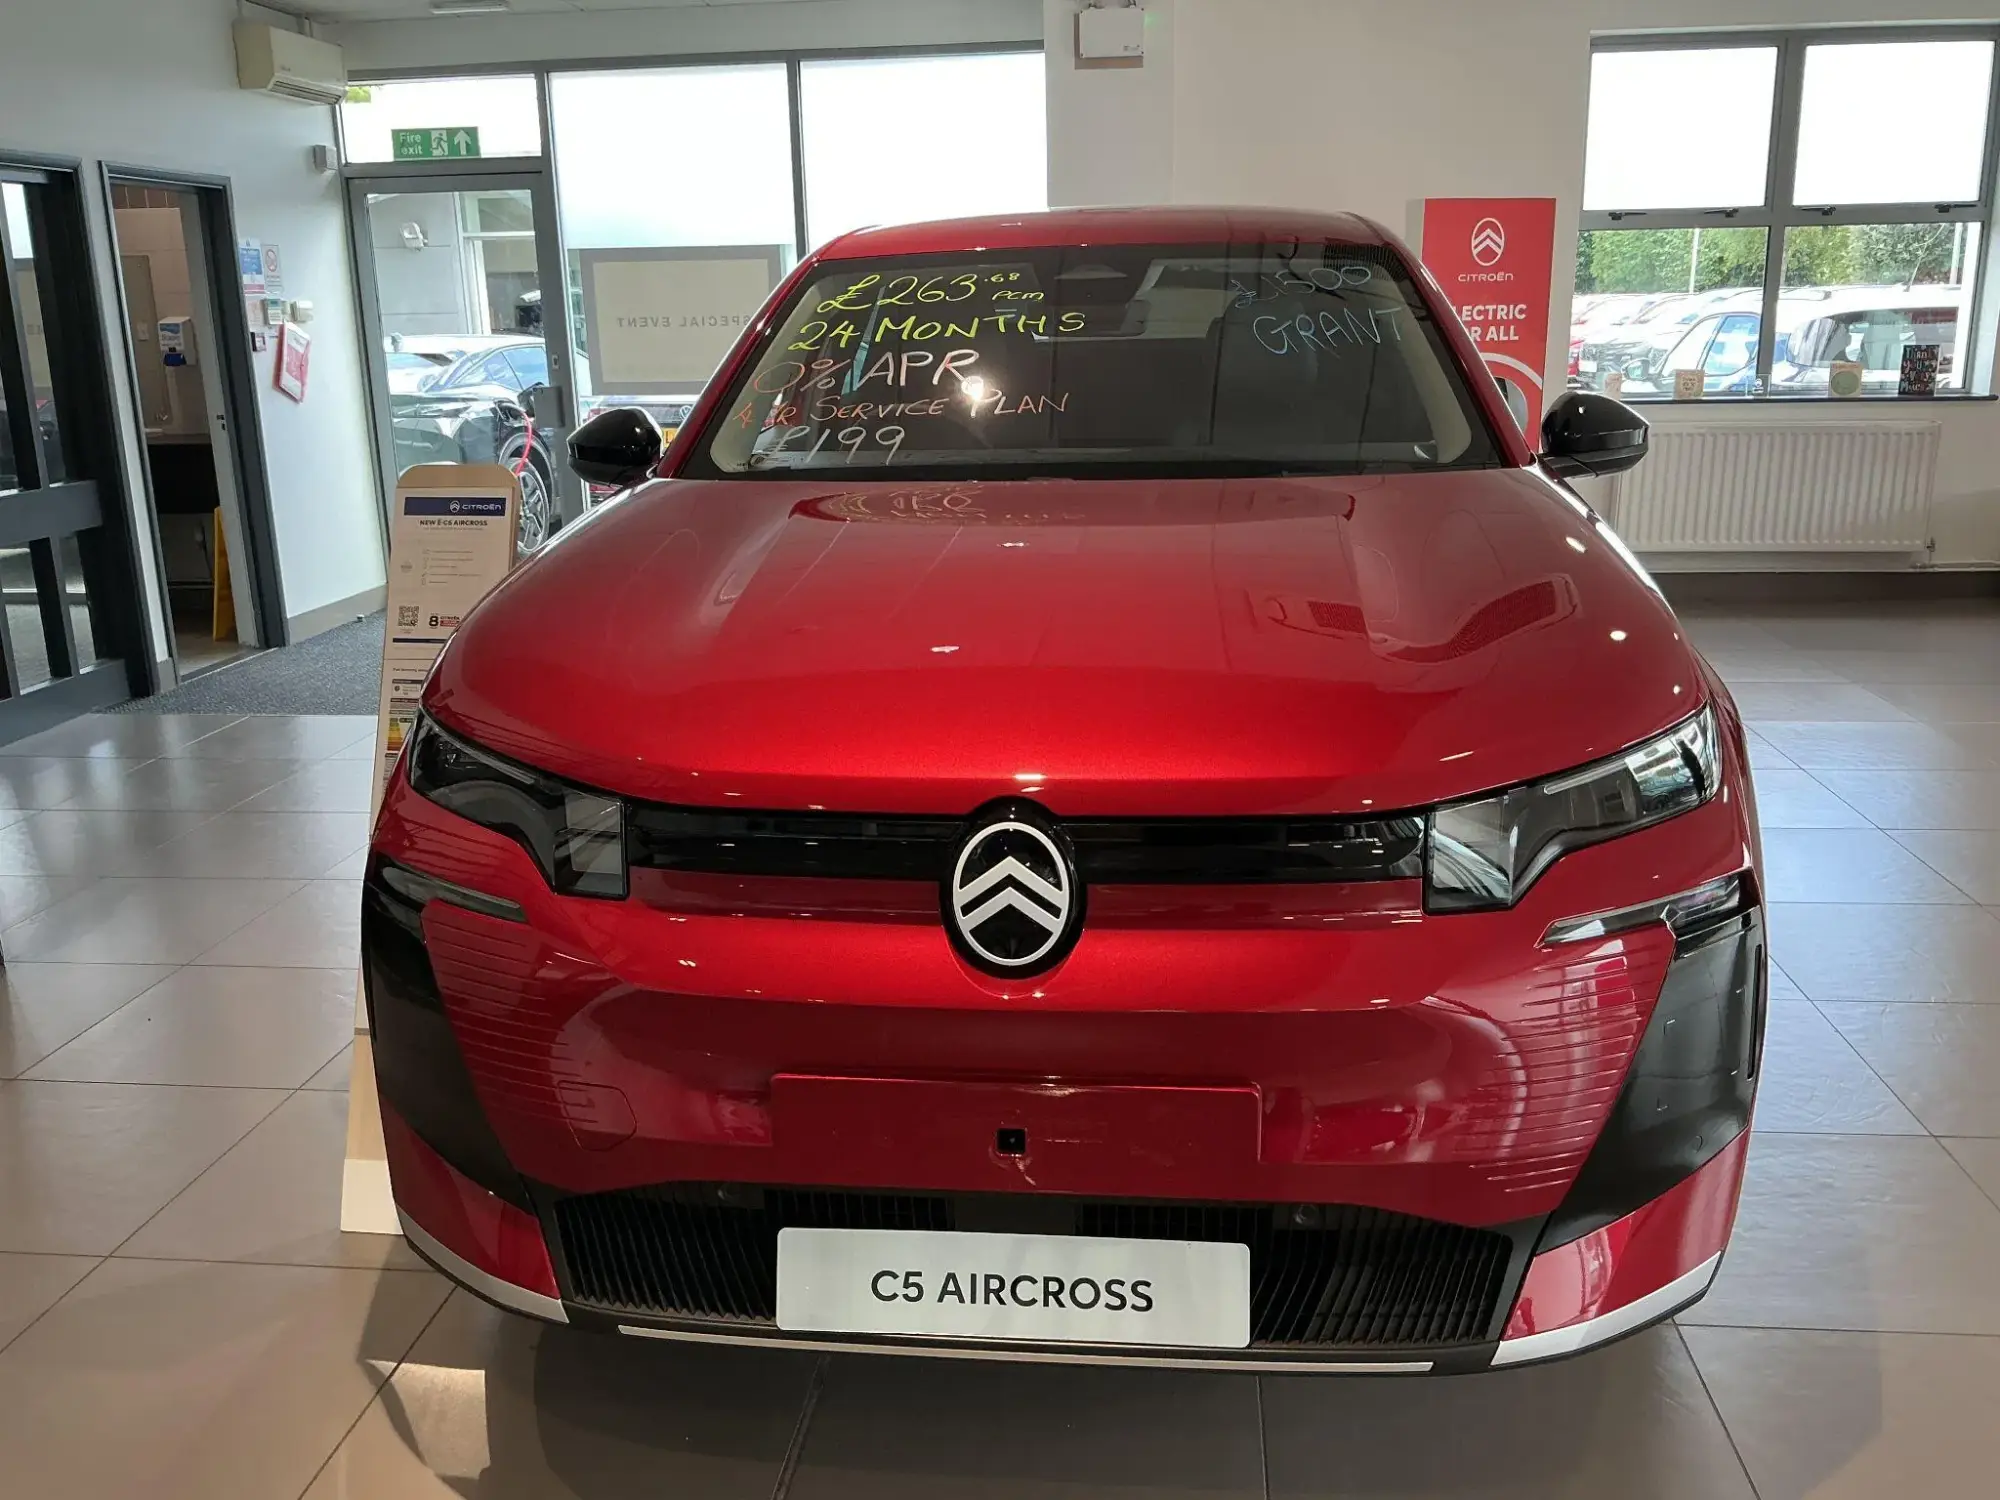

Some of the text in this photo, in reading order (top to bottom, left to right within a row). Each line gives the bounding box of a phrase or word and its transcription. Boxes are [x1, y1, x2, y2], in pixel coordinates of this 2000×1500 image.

[400, 132, 422, 143] Fire
[401, 144, 423, 155] exit
[1452, 303, 1528, 321] ECTRIC
[787, 312, 1086, 351] 24 MONTHS
[1252, 306, 1402, 355] GRANT
[1485, 325, 1520, 342] ALL
[753, 349, 980, 394] 0% APR
[810, 395, 951, 422] SERVICE
[968, 388, 1069, 418] PLAN
[766, 425, 906, 467] £199
[419, 519, 435, 527] NEW
[453, 519, 489, 527] AIRCROSS
[429, 615, 439, 627] 8
[870, 1269, 1154, 1313] C5 AIRCROSS
